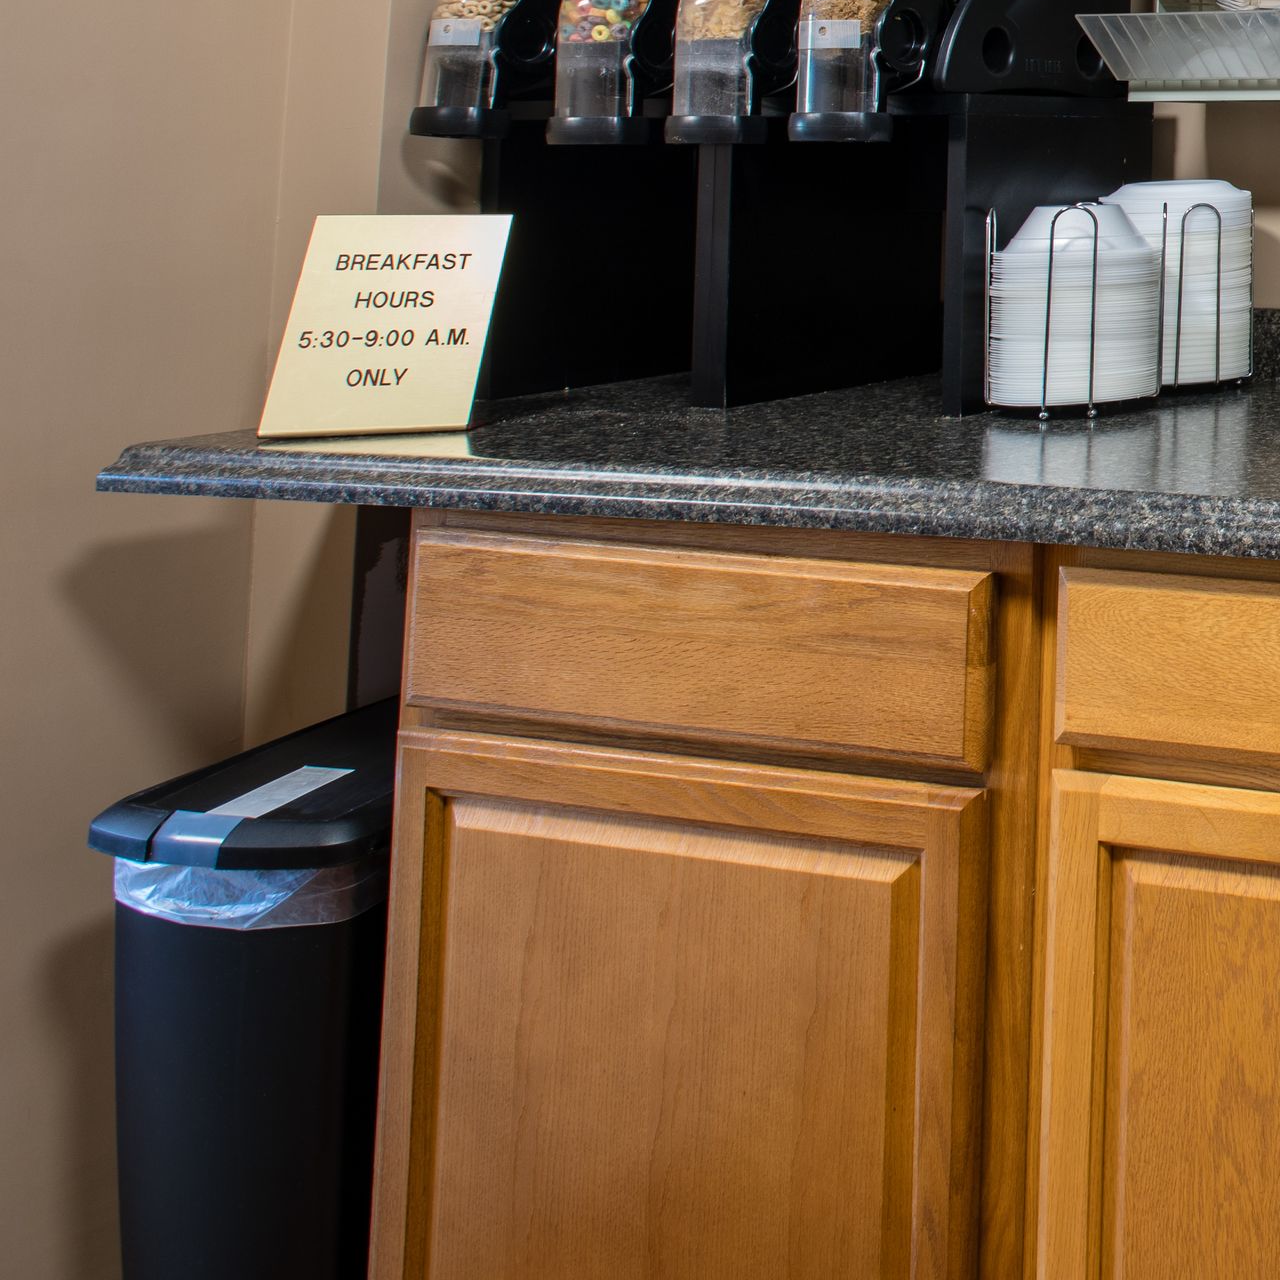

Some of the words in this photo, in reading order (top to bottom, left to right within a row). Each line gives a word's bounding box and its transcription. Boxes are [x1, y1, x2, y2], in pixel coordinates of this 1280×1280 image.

[335, 253, 473, 271] BREAKFAST
[353, 290, 435, 309] HOURS
[298, 329, 415, 349] 5:30-9:00
[424, 328, 471, 346] A.M.
[346, 367, 409, 387] ONLY
